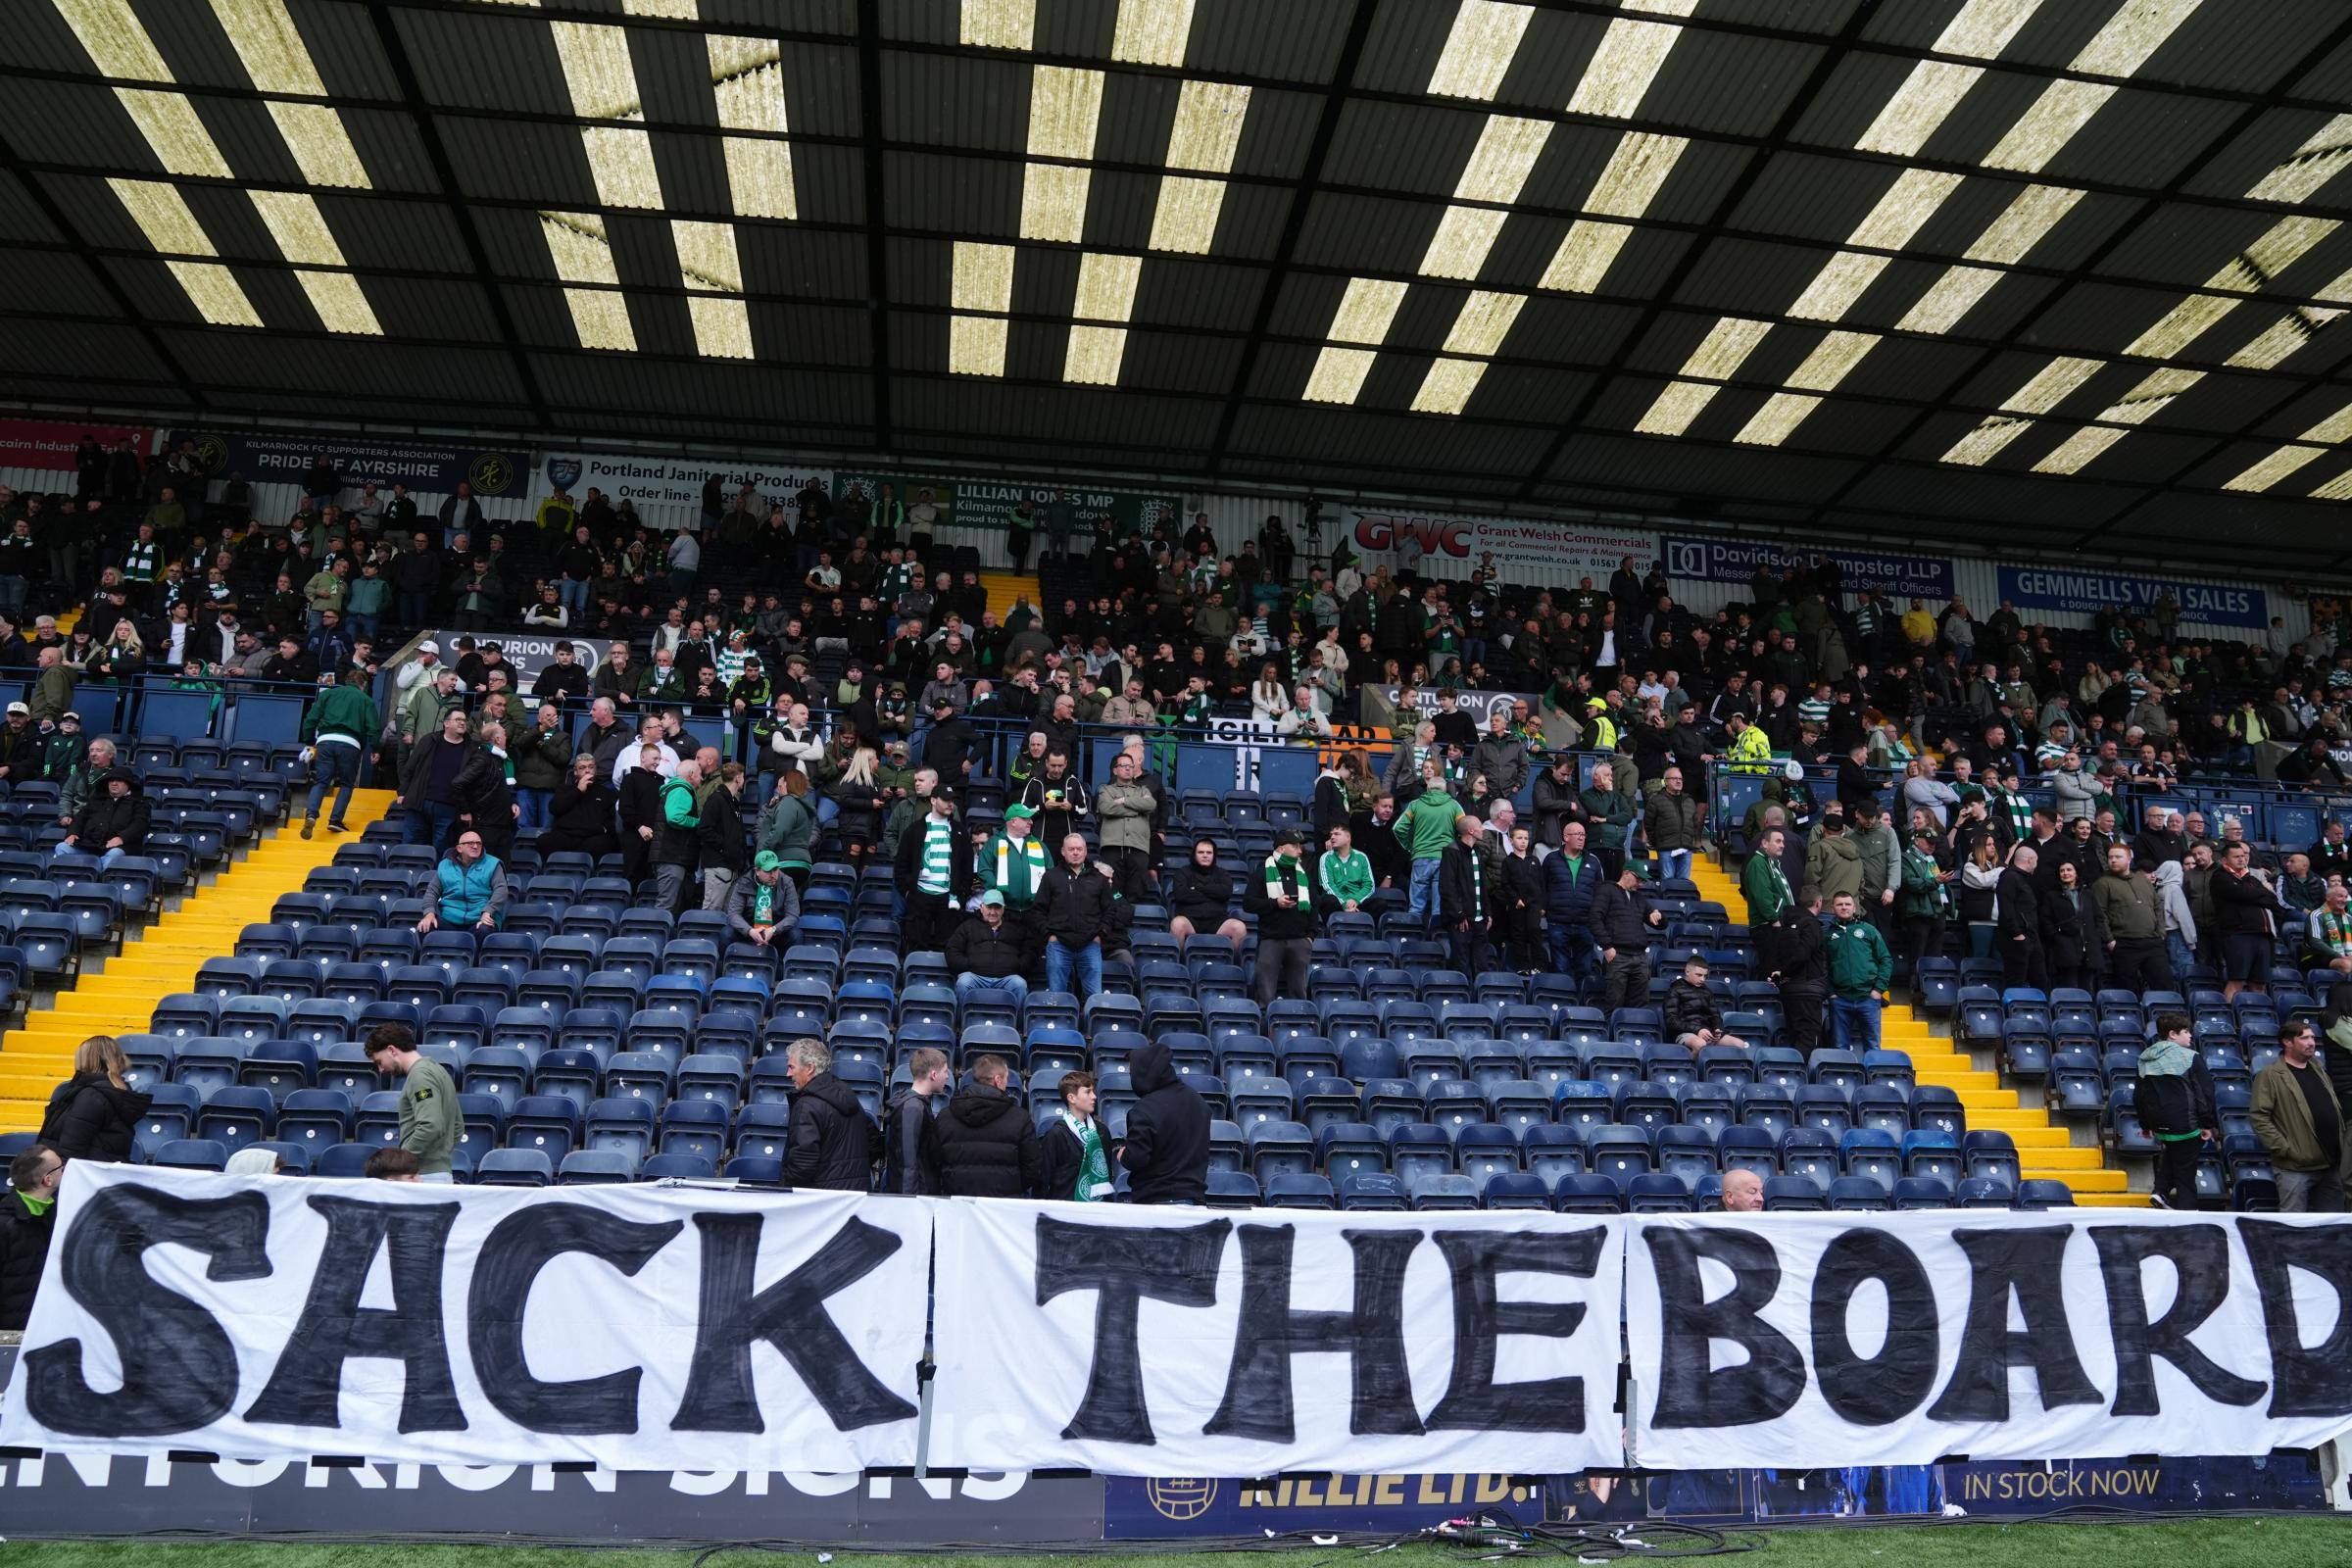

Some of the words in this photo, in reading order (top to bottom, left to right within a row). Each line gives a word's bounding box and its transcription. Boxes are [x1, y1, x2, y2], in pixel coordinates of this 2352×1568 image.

[246, 440, 310, 452] KILMARNOCK
[312, 444, 325, 454] FC
[327, 445, 389, 458] SUPPORTERS
[392, 450, 456, 462] ASSOCIATION
[258, 454, 314, 469] PRIDE
[349, 459, 440, 478] AYRSHIRE
[590, 461, 664, 479] Portland
[668, 466, 750, 486] Janitrial
[619, 485, 662, 500] Order
[664, 488, 691, 502] line
[956, 484, 1022, 502] LILLIAN
[1087, 494, 1114, 508] MP
[956, 514, 985, 523] proud
[988, 515, 998, 524] to
[1350, 512, 1474, 558] GWC
[1477, 524, 1518, 537] Grant
[1519, 527, 1561, 541] Welsh
[1563, 531, 1652, 549] Commercials
[1508, 541, 1556, 552] Commercial
[1559, 545, 1589, 556] Repairs
[1600, 549, 1651, 561] Maintenance
[1713, 545, 1803, 567] Davidson
[1907, 561, 1941, 579] LLP
[1899, 581, 1942, 596] Officers
[2017, 571, 2133, 603] GEMMELLS
[2186, 587, 2250, 613] SALES
[24, 1182, 918, 1438] SACK
[1035, 1212, 1608, 1446] THE
[1642, 1216, 2352, 1430] BOARD
[1964, 1474, 1992, 1500] IN
[1998, 1469, 2084, 1499] STOCK
[2091, 1468, 2160, 1497] NOW
